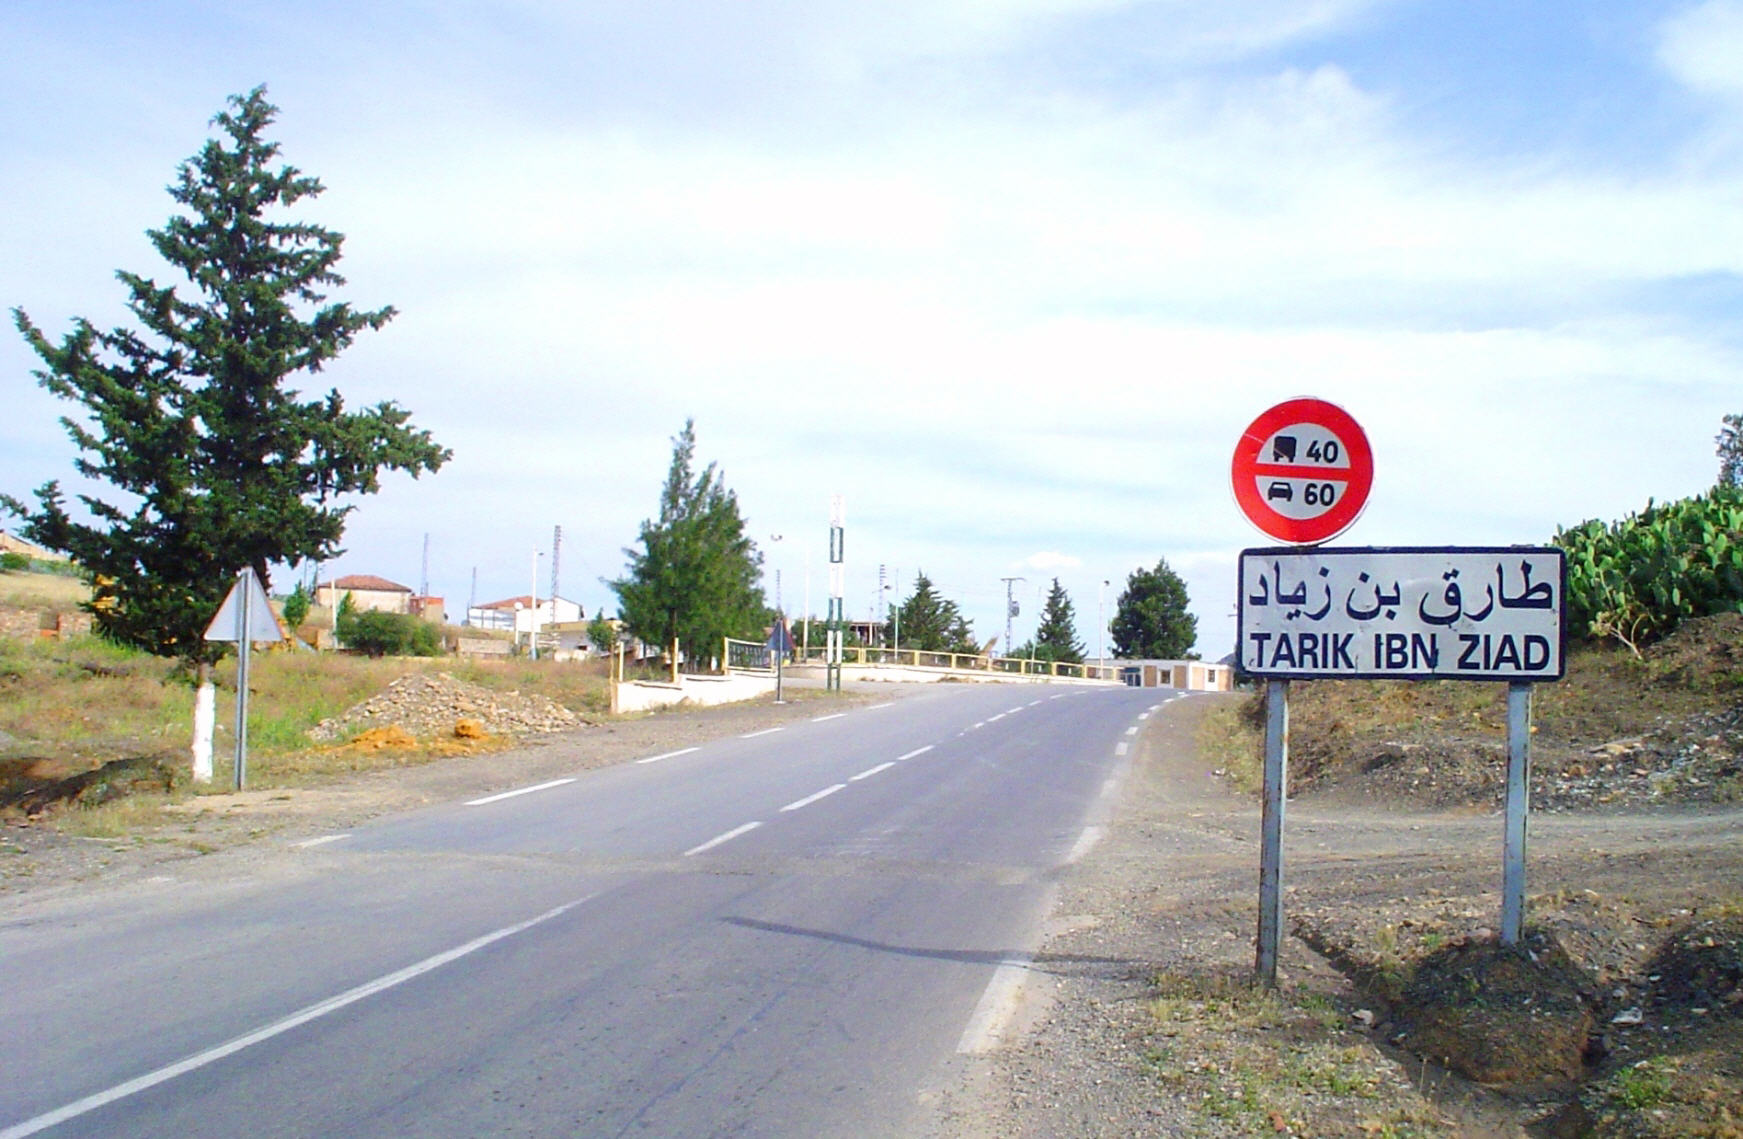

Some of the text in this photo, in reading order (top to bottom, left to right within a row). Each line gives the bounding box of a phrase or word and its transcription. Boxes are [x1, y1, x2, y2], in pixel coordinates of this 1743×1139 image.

[1306, 441, 1339, 463] 40
[1304, 483, 1335, 506] 60
[1249, 559, 1554, 626] طارق بن زياد
[1249, 632, 1551, 671] TARIK IBN ZIAD
